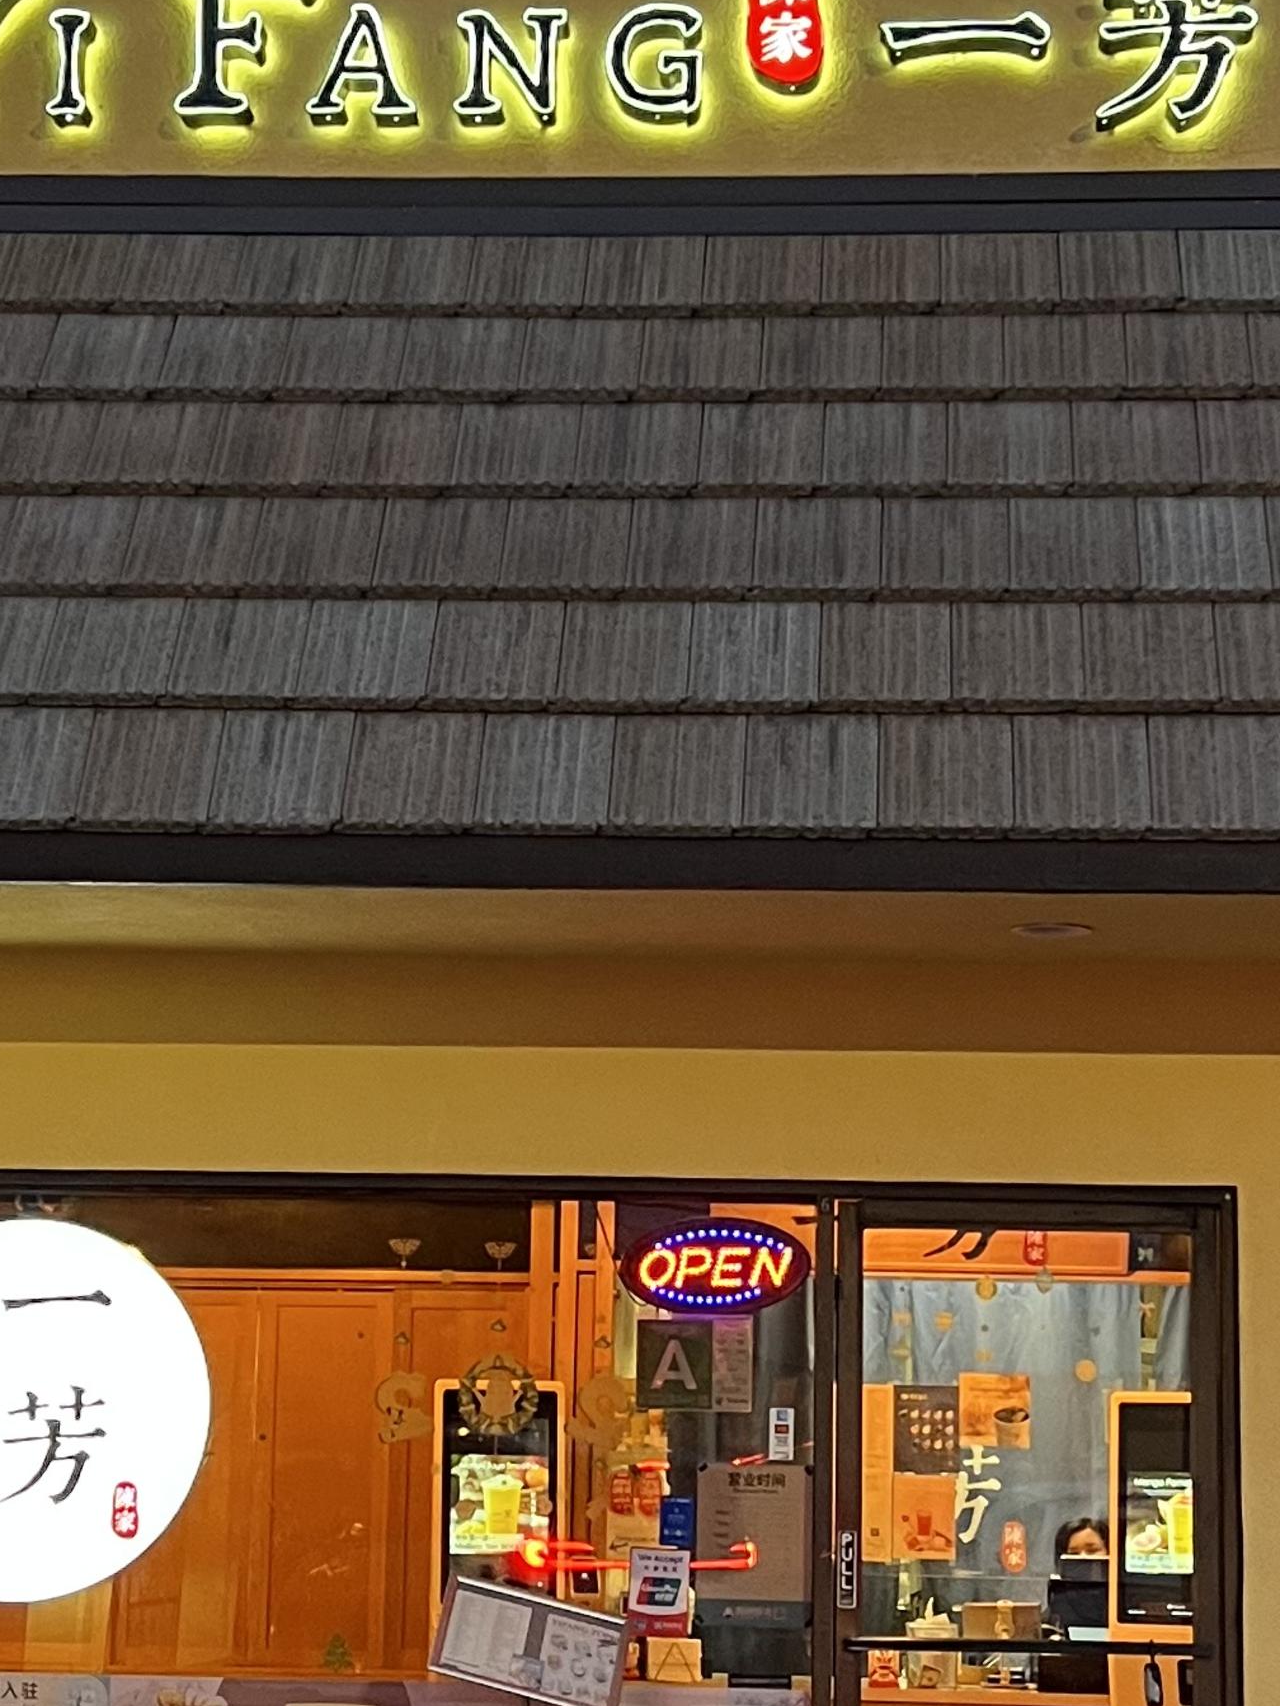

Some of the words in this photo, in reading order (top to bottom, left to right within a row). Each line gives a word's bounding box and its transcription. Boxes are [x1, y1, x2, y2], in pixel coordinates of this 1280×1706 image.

[639, 1246, 793, 1289] OPEN
[650, 1339, 698, 1390] A
[0, 1289, 112, 1504] 一芳
[842, 1533, 852, 1590] PULL
